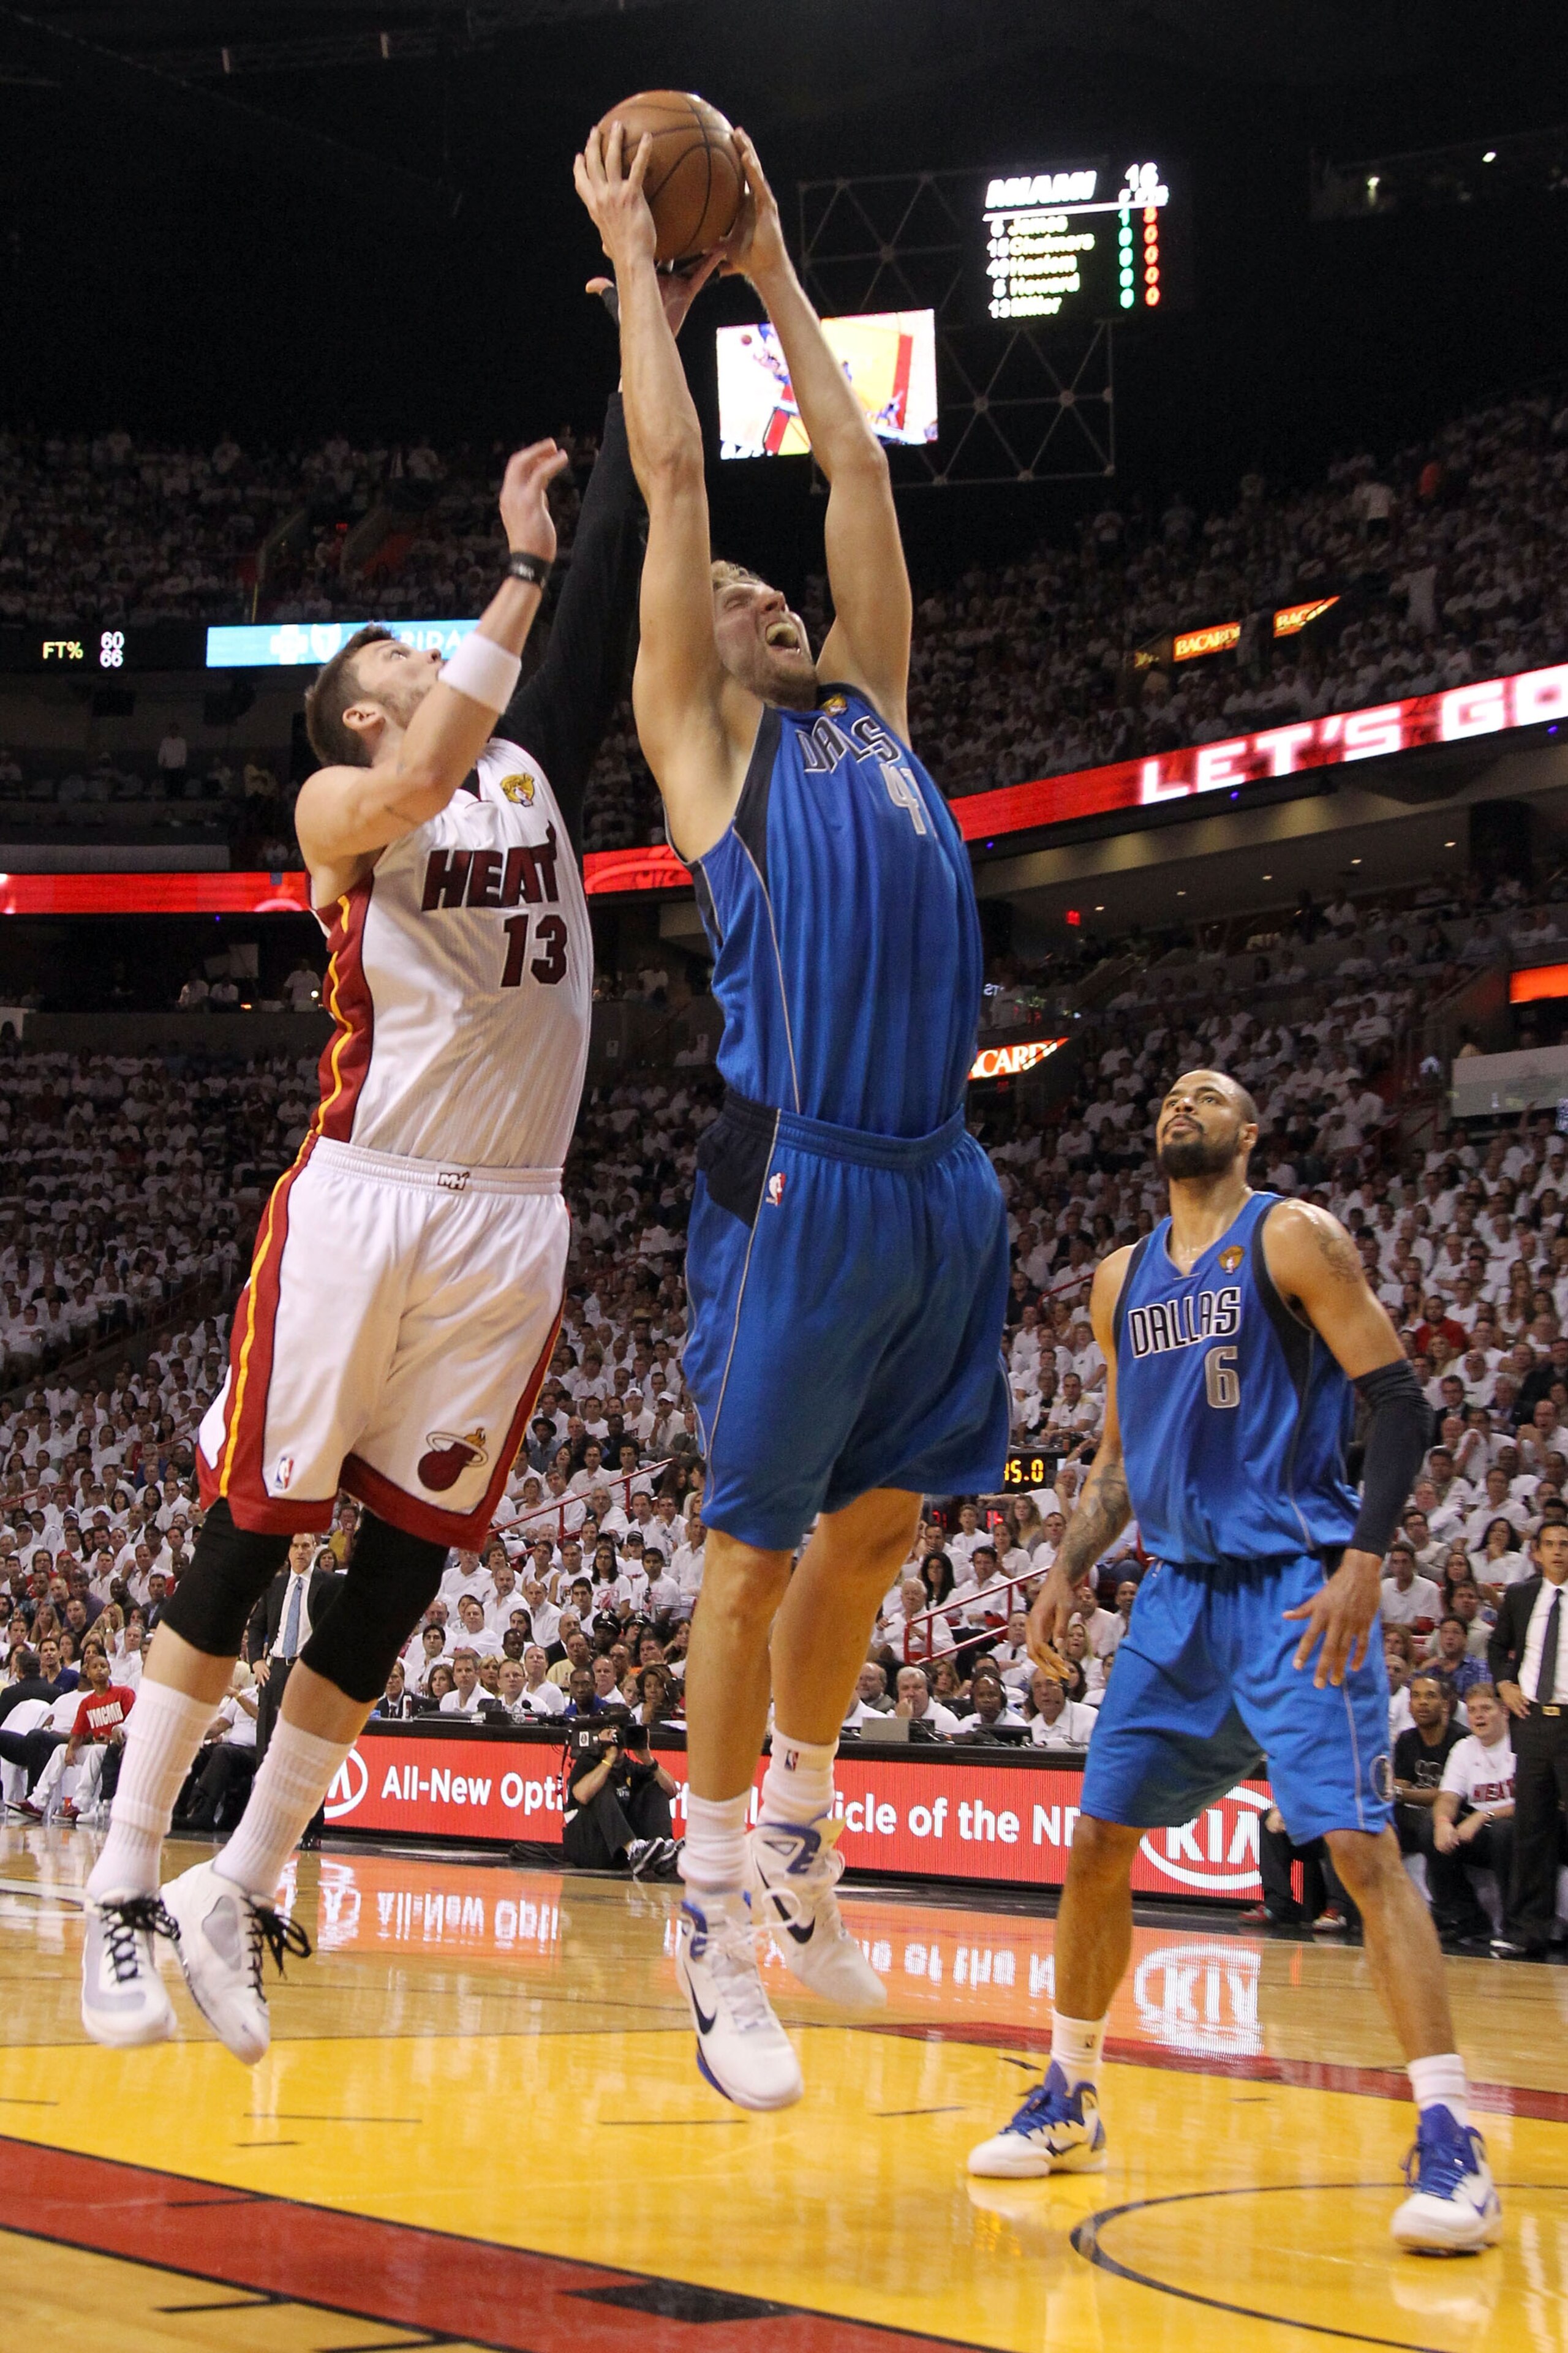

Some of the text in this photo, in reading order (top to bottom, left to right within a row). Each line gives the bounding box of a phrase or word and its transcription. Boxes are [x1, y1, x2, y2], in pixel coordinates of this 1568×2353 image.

[42, 641, 84, 660] FT%
[99, 649, 124, 668] 66
[101, 631, 125, 650] 60
[1140, 664, 1568, 805] LET'S GO
[880, 763, 927, 835] 4
[420, 819, 559, 912] HEAT
[500, 913, 568, 988] 13
[1128, 1286, 1242, 1359] DALLAS
[1204, 1346, 1241, 1409] 6
[380, 1765, 492, 1806] All-New
[500, 1771, 565, 1816] Opti
[908, 1795, 948, 1839] of
[957, 1799, 1020, 1844] the
[1166, 1808, 1261, 1865] KIA
